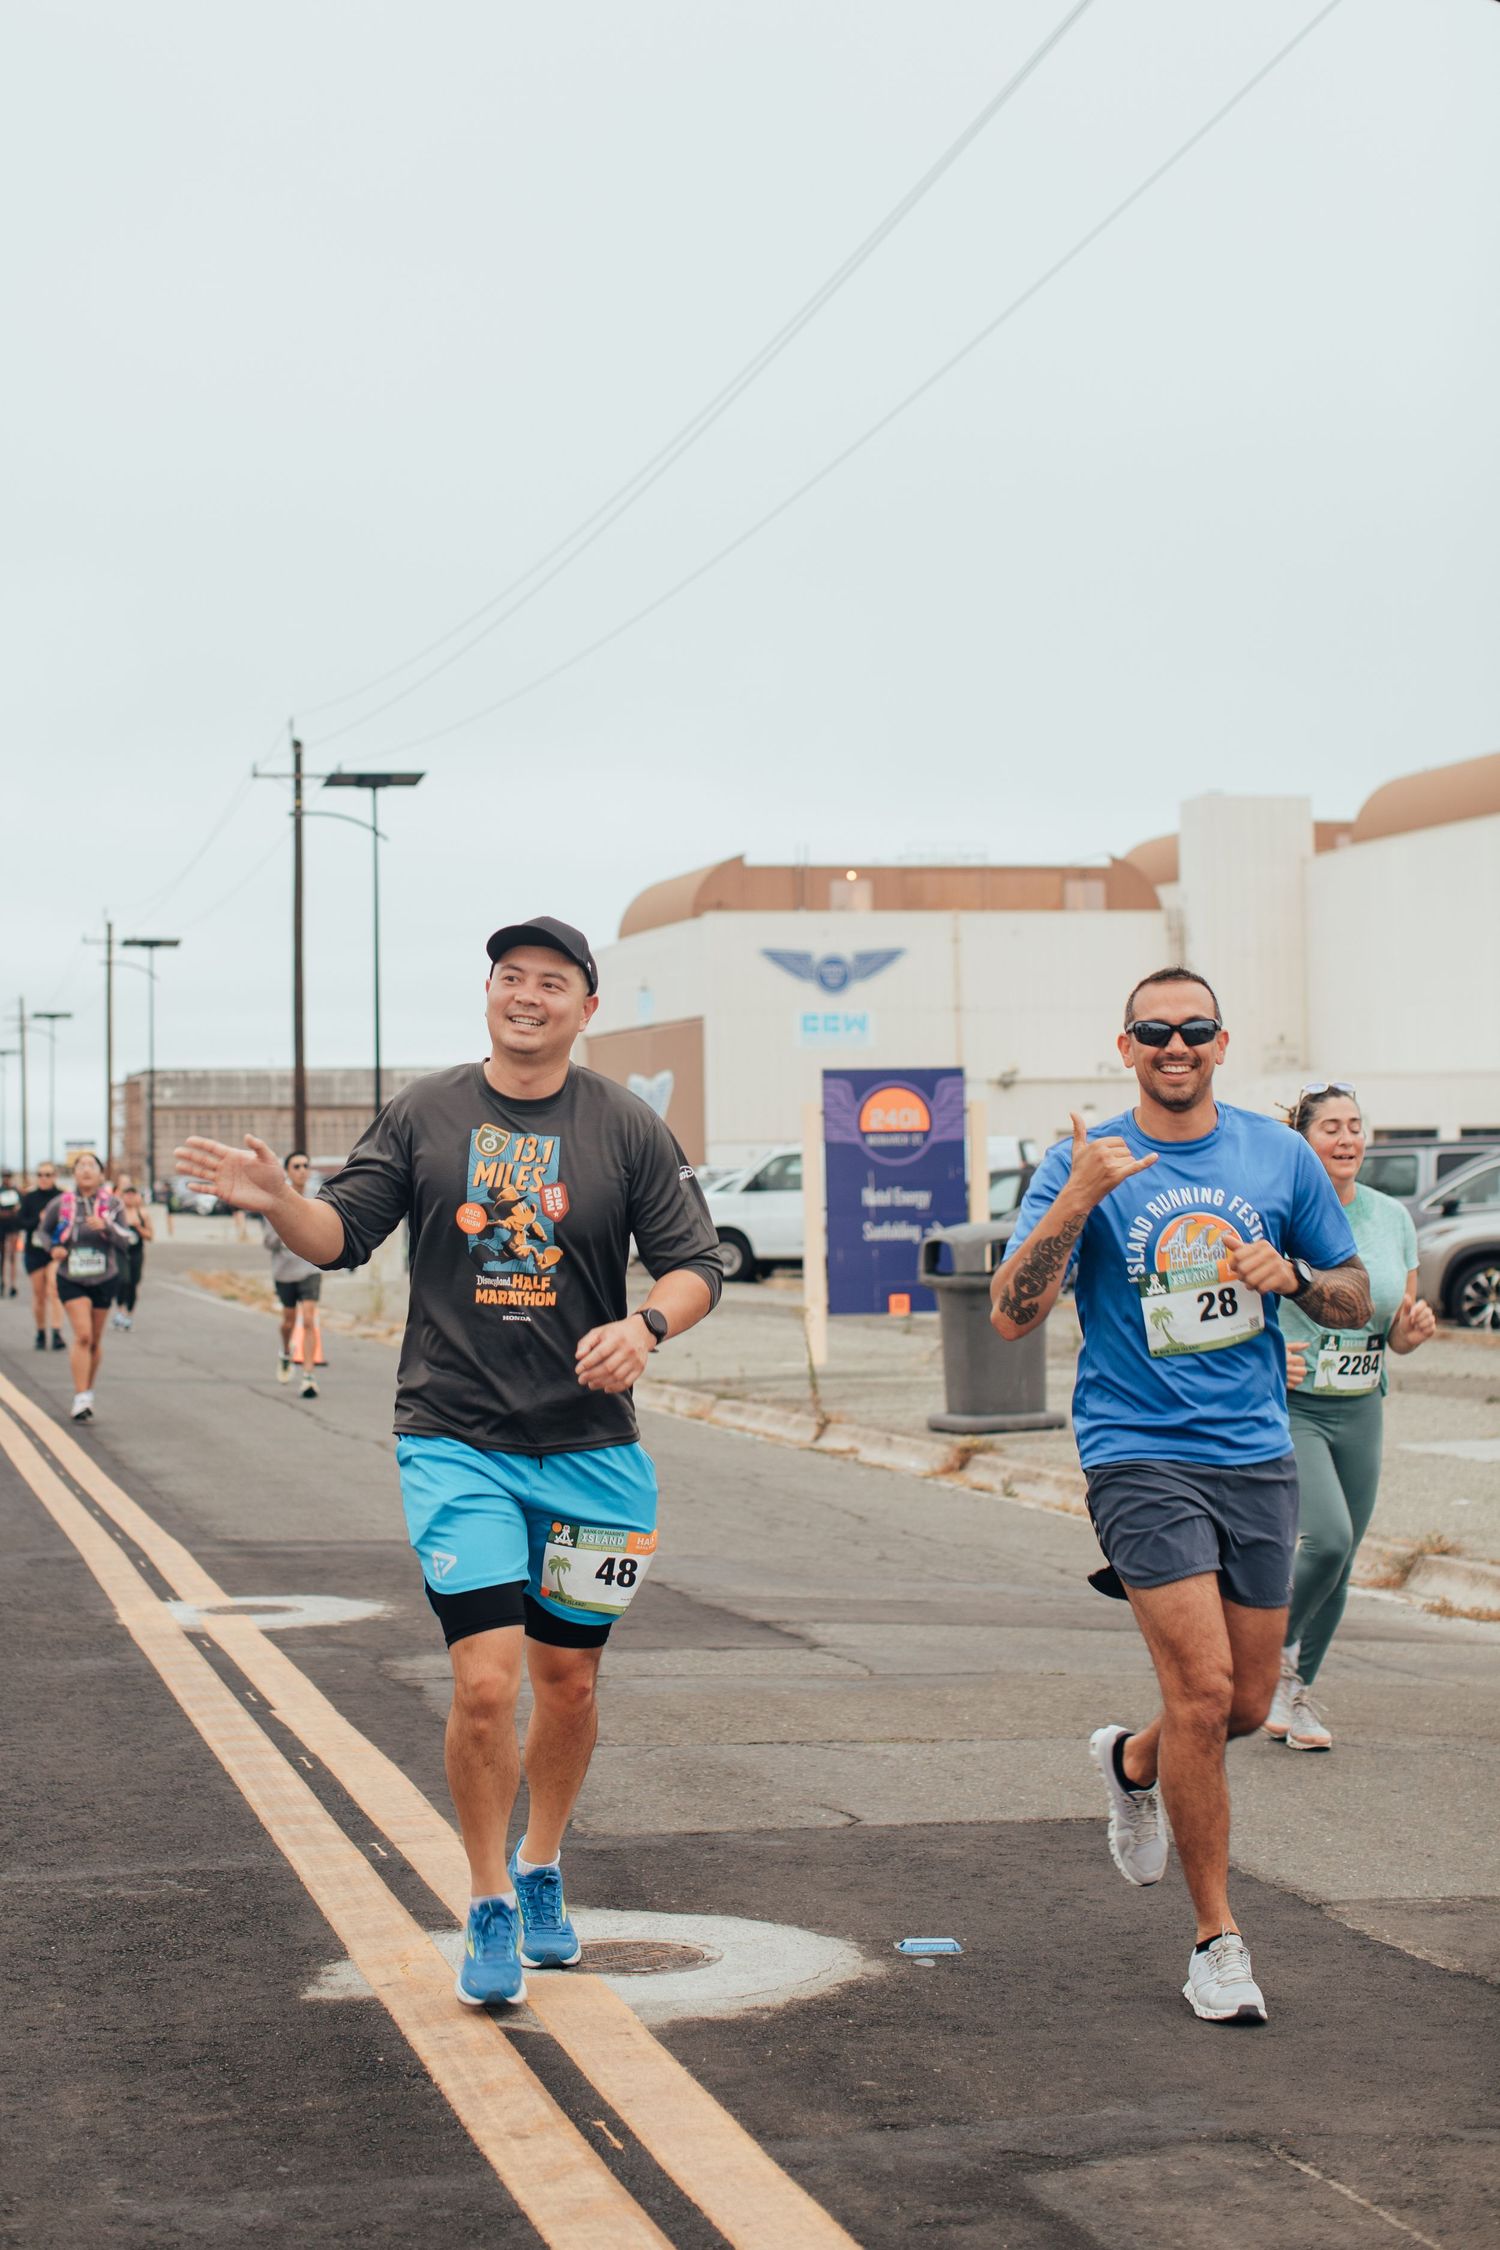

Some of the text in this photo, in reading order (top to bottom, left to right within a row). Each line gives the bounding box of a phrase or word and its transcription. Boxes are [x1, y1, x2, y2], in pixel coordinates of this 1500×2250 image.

[869, 1108, 921, 1130] 2401
[513, 1136, 555, 1164] 13.1
[472, 1160, 547, 1193] MILES
[544, 1186, 562, 1200] 20
[1145, 1187, 1225, 1219] RUNNING
[546, 1199, 563, 1212] 25
[512, 1274, 551, 1291] HALF
[475, 1288, 557, 1306] MARATHON
[1197, 1287, 1238, 1322] 28
[1337, 1354, 1380, 1376] 2284
[581, 1533, 624, 1546] ISLAND
[595, 1556, 638, 1588] 48
